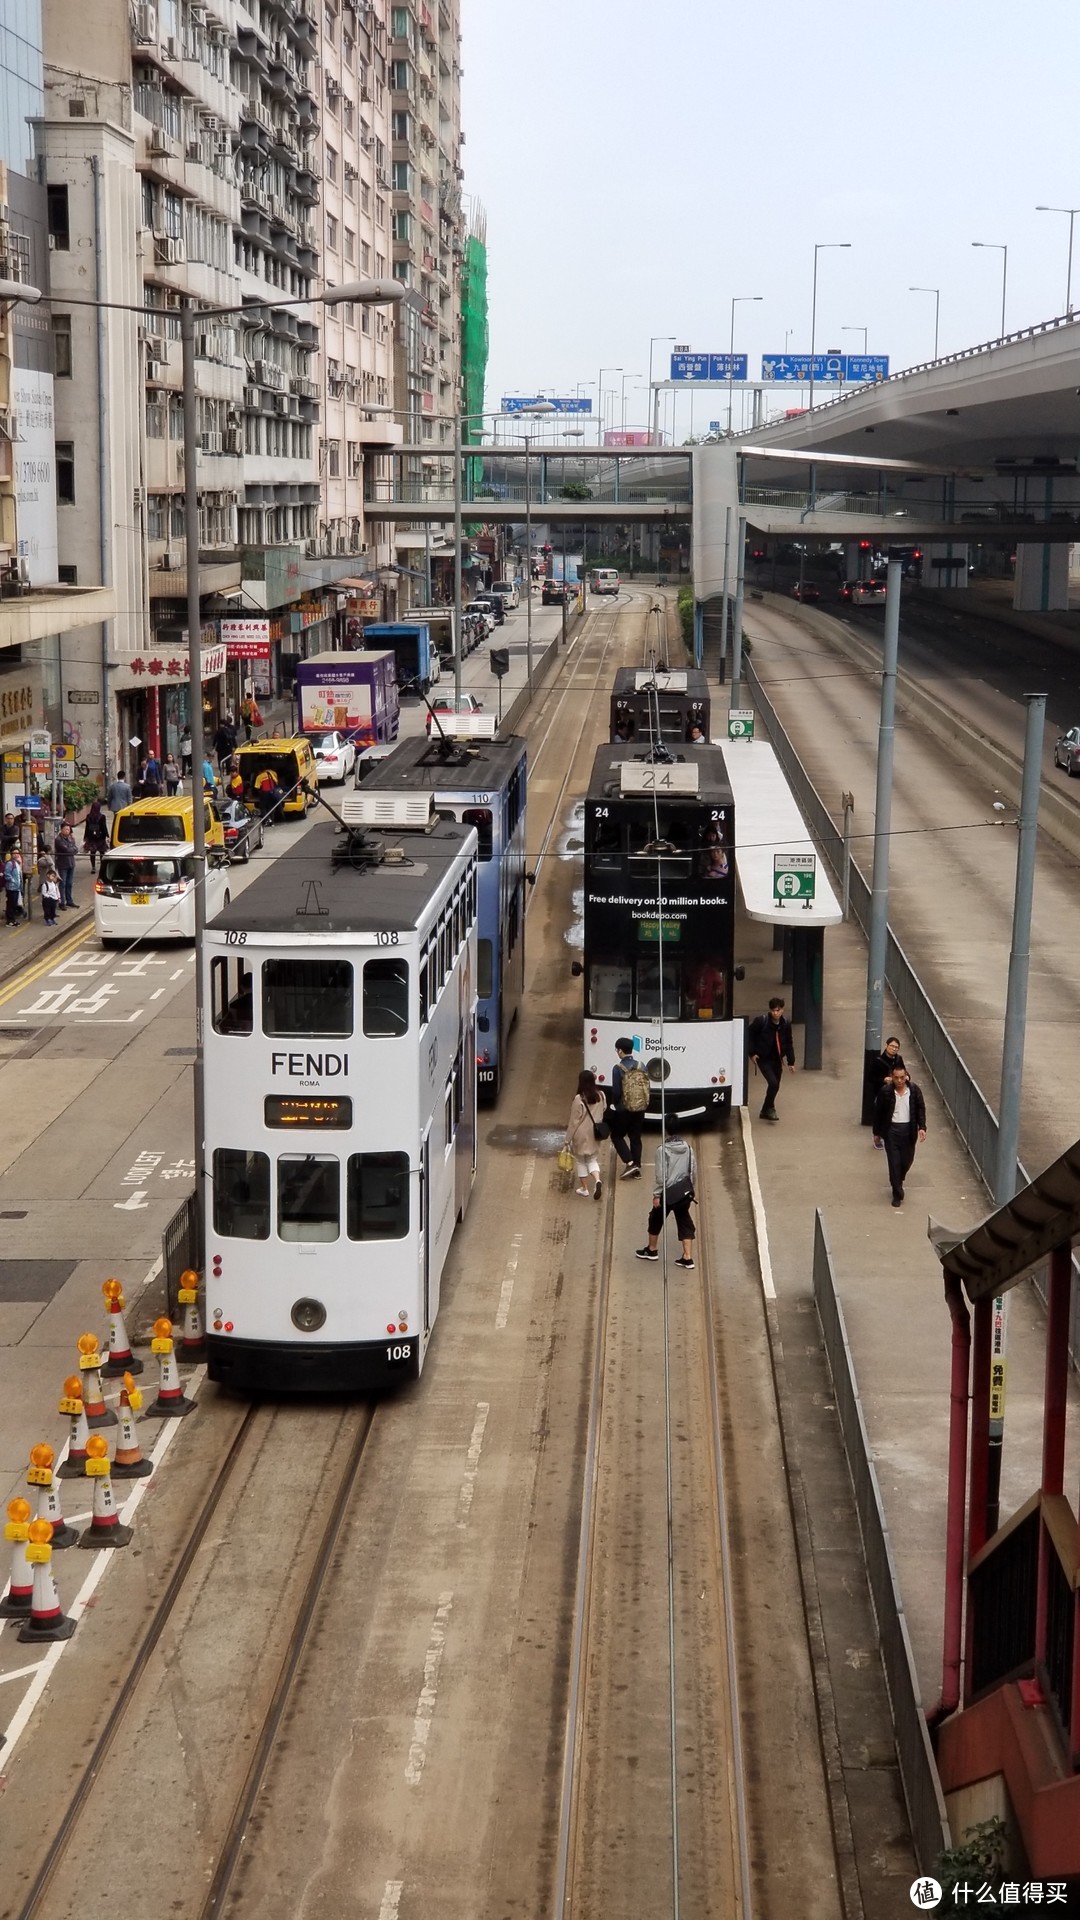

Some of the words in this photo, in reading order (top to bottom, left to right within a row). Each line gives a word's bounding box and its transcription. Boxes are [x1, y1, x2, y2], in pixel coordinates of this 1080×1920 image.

[642, 771, 674, 789] 24
[472, 794, 489, 803] 110
[595, 808, 609, 818] 24
[711, 811, 725, 820] 24
[589, 895, 606, 903] Free
[608, 896, 642, 906] delivery
[700, 897, 728, 905] books.
[632, 911, 687, 920] bookdepo.com
[641, 922, 660, 930] Happy
[224, 931, 248, 945] 108
[374, 931, 400, 946] 108
[48, 951, 167, 977] 巴士
[17, 983, 120, 1014] 站
[272, 1053, 348, 1076] FENDI
[479, 1071, 494, 1082] 110
[712, 1092, 725, 1103] 24
[386, 1345, 411, 1361] 108
[992, 1364, 1004, 1387] 免費
